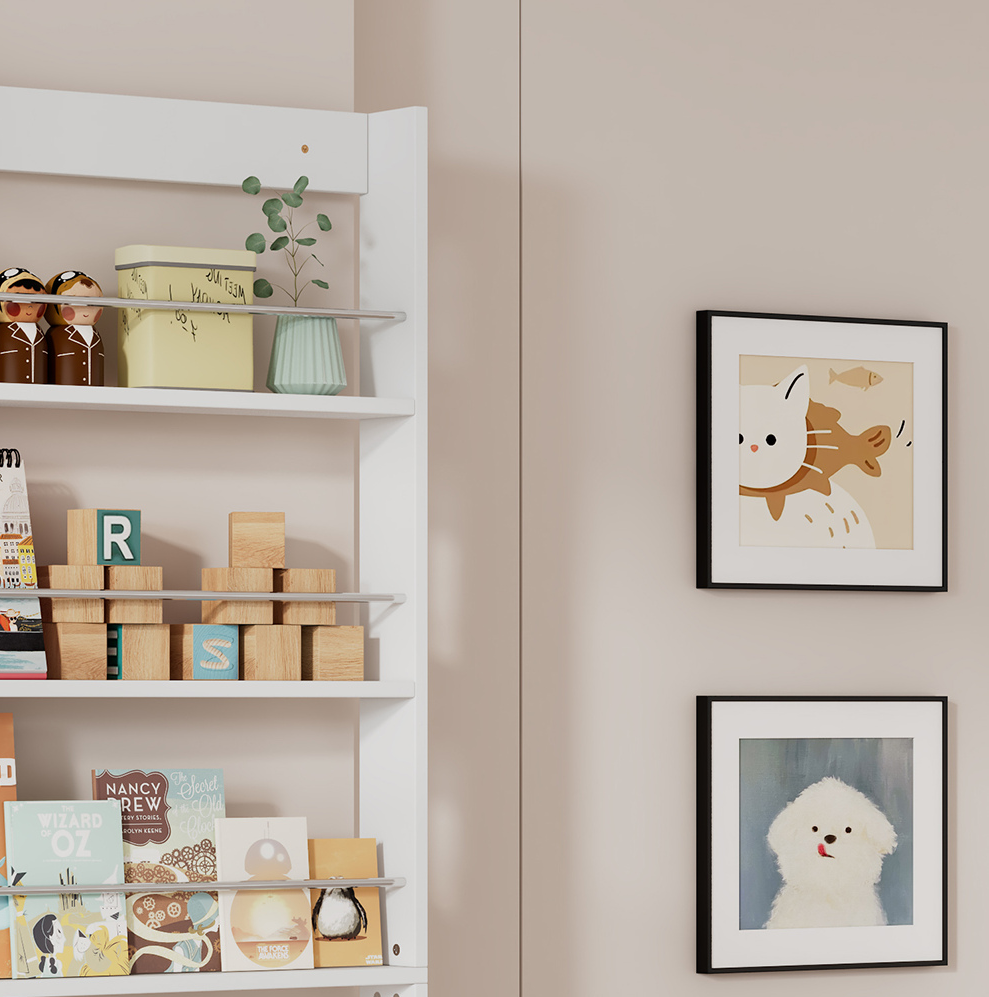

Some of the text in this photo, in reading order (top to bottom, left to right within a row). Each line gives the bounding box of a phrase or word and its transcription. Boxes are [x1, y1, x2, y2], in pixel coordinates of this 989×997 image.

[103, 515, 134, 560] R
[200, 638, 232, 670] S
[106, 782, 161, 795] NANCY
[177, 774, 220, 800] Secret
[108, 796, 162, 812] REW
[192, 793, 224, 818] Old
[37, 812, 103, 829] WIZARD
[40, 829, 52, 838] OF
[51, 829, 92, 858] OZ
[257, 945, 268, 953] THE
[258, 951, 290, 960] AWAKENS
